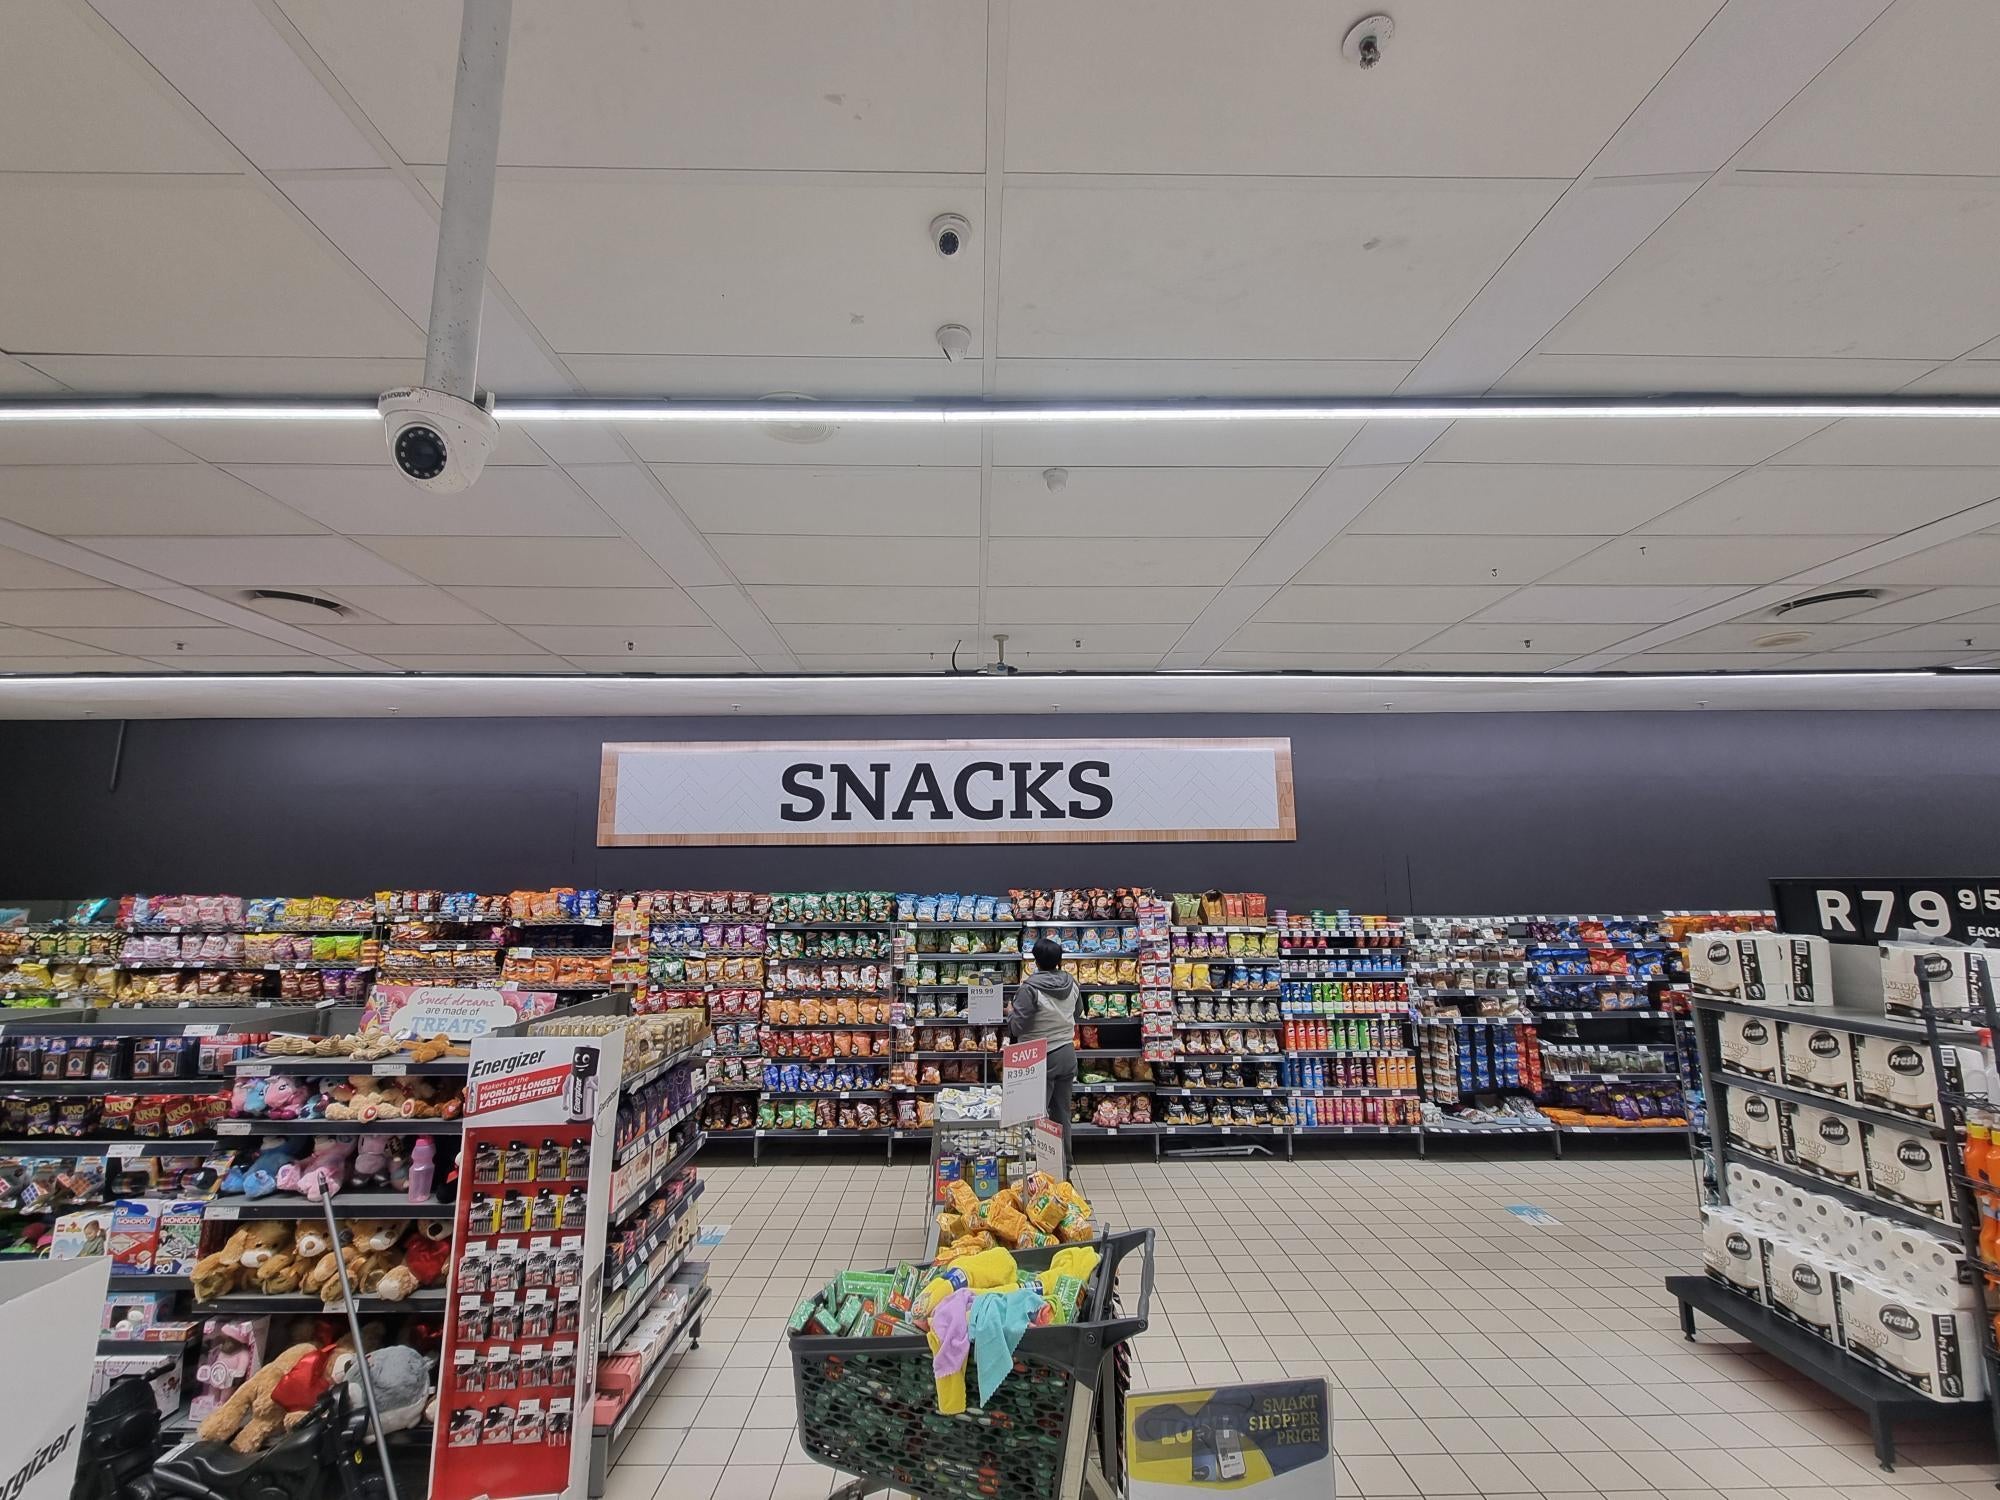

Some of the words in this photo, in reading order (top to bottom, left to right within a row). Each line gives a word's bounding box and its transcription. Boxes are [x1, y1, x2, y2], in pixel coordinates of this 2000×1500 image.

[780, 760, 1113, 822] SNACKS
[1709, 947, 1727, 958] Fresh
[418, 991, 451, 1006] Sweet
[452, 994, 495, 1007] dreams
[442, 1007, 468, 1015] made
[470, 1008, 480, 1016] of
[411, 1016, 486, 1034] TREATS
[1744, 1027, 1764, 1037] Fresh
[1811, 1039, 1835, 1050] Fresh
[1012, 1047, 1038, 1063] SAVE
[1890, 1053, 1919, 1066] Fresh
[470, 1050, 545, 1078] Energizer
[1007, 1067, 1036, 1080] R39.99
[480, 1084, 521, 1100] WORLD'S
[522, 1075, 563, 1091] LONGEST
[481, 1081, 507, 1092] Makers
[517, 1076, 529, 1084] the
[479, 1095, 518, 1109] LASTING
[519, 1084, 560, 1100] BATTERY
[574, 1077, 583, 1113] Energizer
[27, 1103, 49, 1116] UNO
[62, 1105, 85, 1115] UNO
[105, 1101, 133, 1113] UNO
[167, 1103, 191, 1121] UNO
[207, 1101, 226, 1113] UNO
[1746, 1103, 1765, 1113] Fresh
[135, 1107, 160, 1121] UNO
[1821, 1125, 1845, 1136] Fresh
[1900, 1148, 1925, 1160] Fresh
[117, 1217, 150, 1225] MONOPOLY
[163, 1216, 200, 1225] MONOPOLY
[1727, 1238, 1748, 1250] Fresh
[155, 1262, 173, 1274] GO!
[1794, 1270, 1817, 1285] Fresh
[1883, 1311, 1914, 1329] Fresh
[1938, 1351, 1949, 1374] Luxury
[1263, 1395, 1318, 1413] SMART
[1249, 1411, 1320, 1431] SHOPPER
[1277, 1428, 1320, 1445] PRICE
